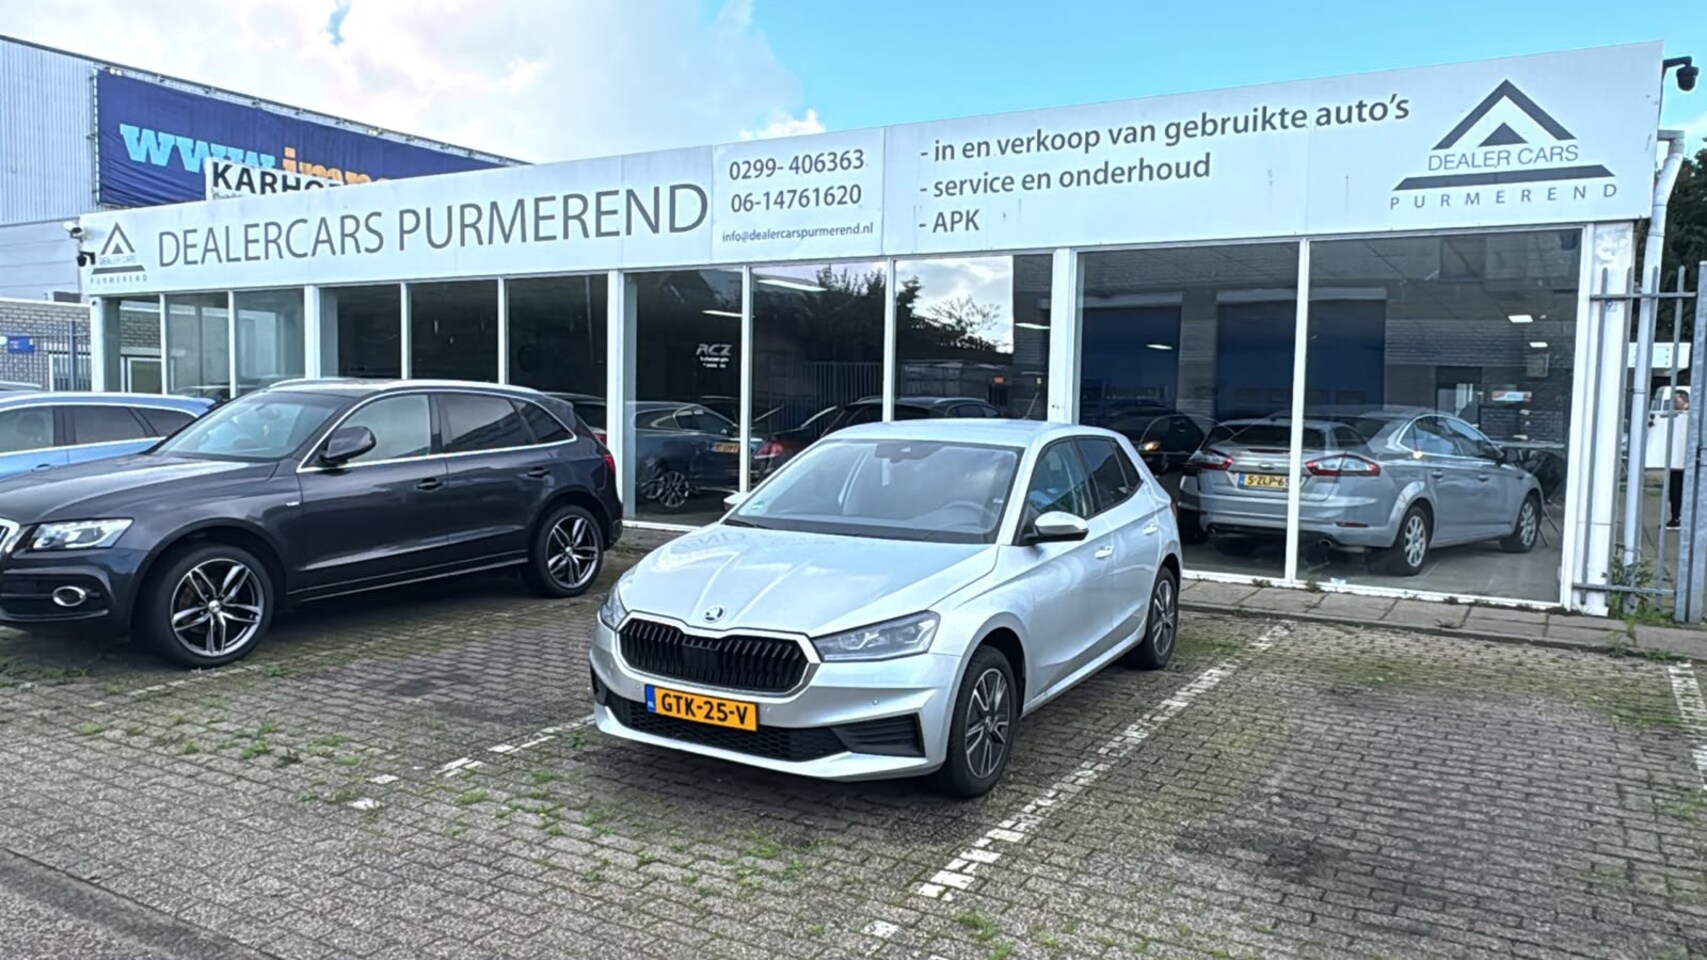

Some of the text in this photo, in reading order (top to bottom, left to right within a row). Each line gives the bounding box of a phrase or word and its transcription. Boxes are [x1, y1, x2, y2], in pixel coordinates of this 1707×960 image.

[934, 139, 955, 162] in
[962, 140, 991, 159] en
[997, 128, 1101, 156] verkoop
[1108, 124, 1156, 145] van
[1164, 106, 1309, 147] gebruikte
[1315, 93, 1410, 127] auto's
[788, 149, 864, 175] 406363
[1428, 144, 1579, 171] DEALER CARS
[212, 161, 344, 195] KARH
[933, 172, 1015, 197] service
[1021, 172, 1051, 191] en
[1058, 152, 1211, 188] onderhoud
[731, 183, 862, 213] 06-14761620
[1389, 183, 1618, 210] PURMEREND
[158, 183, 708, 267] DEALERCARS PURMEREND
[722, 222, 874, 243] info@dealercarspurmerend.nl
[932, 209, 980, 233] APK
[696, 343, 732, 355] RCZ
[661, 692, 748, 725] GTK-25-V
